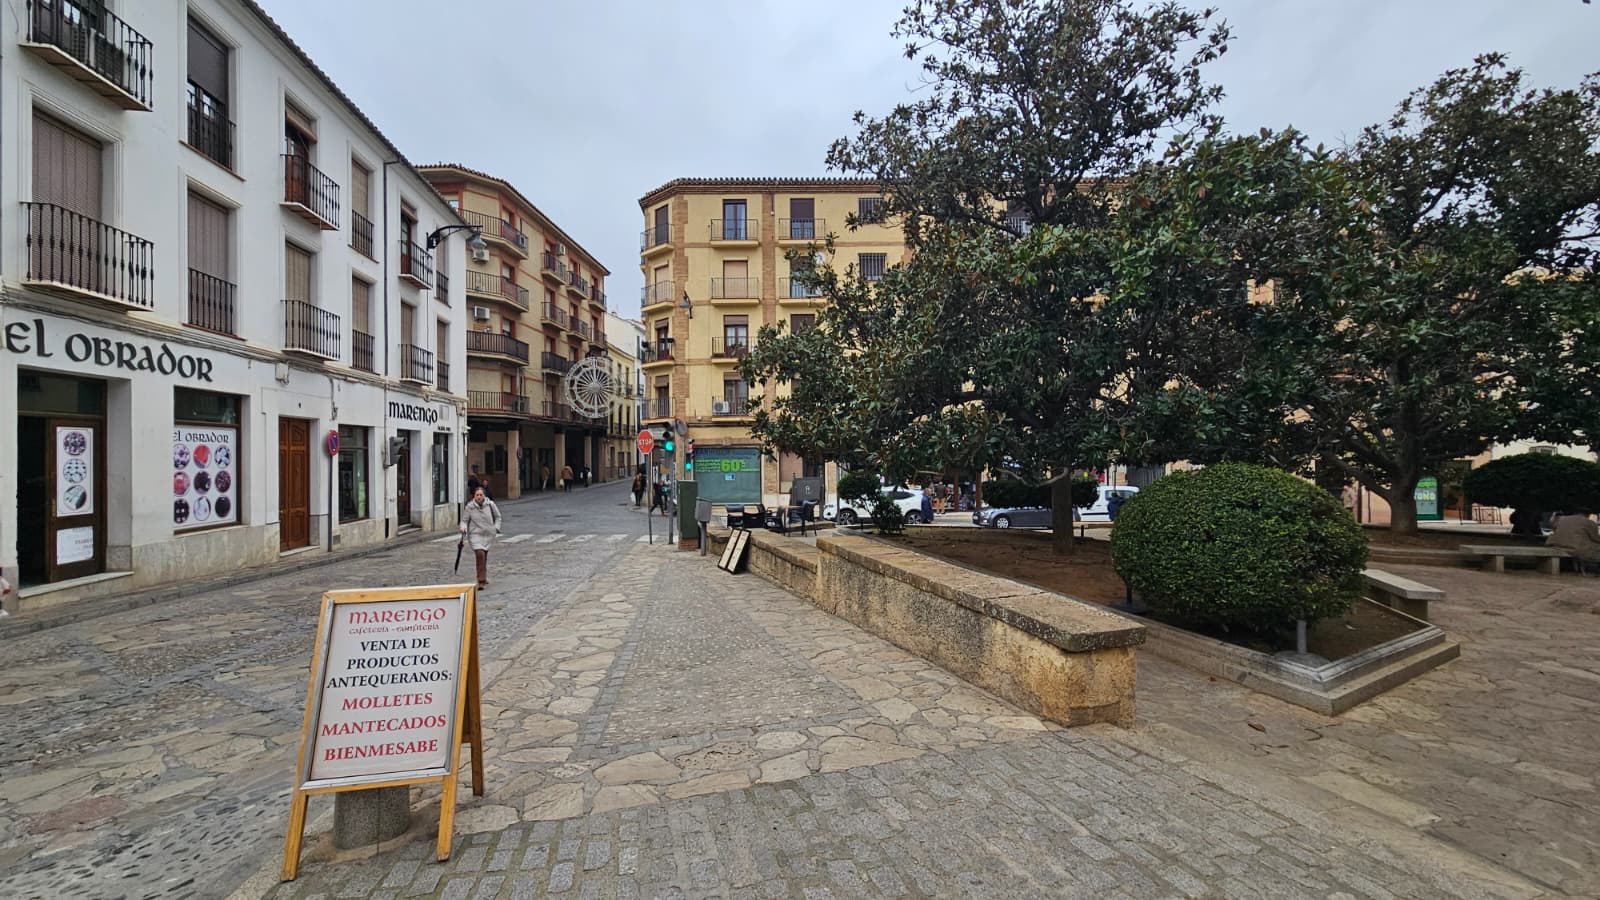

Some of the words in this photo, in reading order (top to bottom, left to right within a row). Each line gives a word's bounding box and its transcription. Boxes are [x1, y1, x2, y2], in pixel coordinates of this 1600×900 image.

[65, 333, 213, 382] OBRADOR
[389, 401, 438, 425] MARENGO
[185, 431, 229, 443] OBRADOR
[639, 438, 652, 446] STOP
[349, 608, 446, 626] MARENGO
[360, 639, 407, 652] VENTA
[411, 637, 431, 650] DE
[347, 653, 439, 670] PRODUCTOS
[326, 670, 453, 689] ANTEQUERANOS:
[342, 693, 433, 710] MOLLETES
[321, 715, 447, 736] MANTECADOS
[324, 740, 438, 761] BIENMESABE
